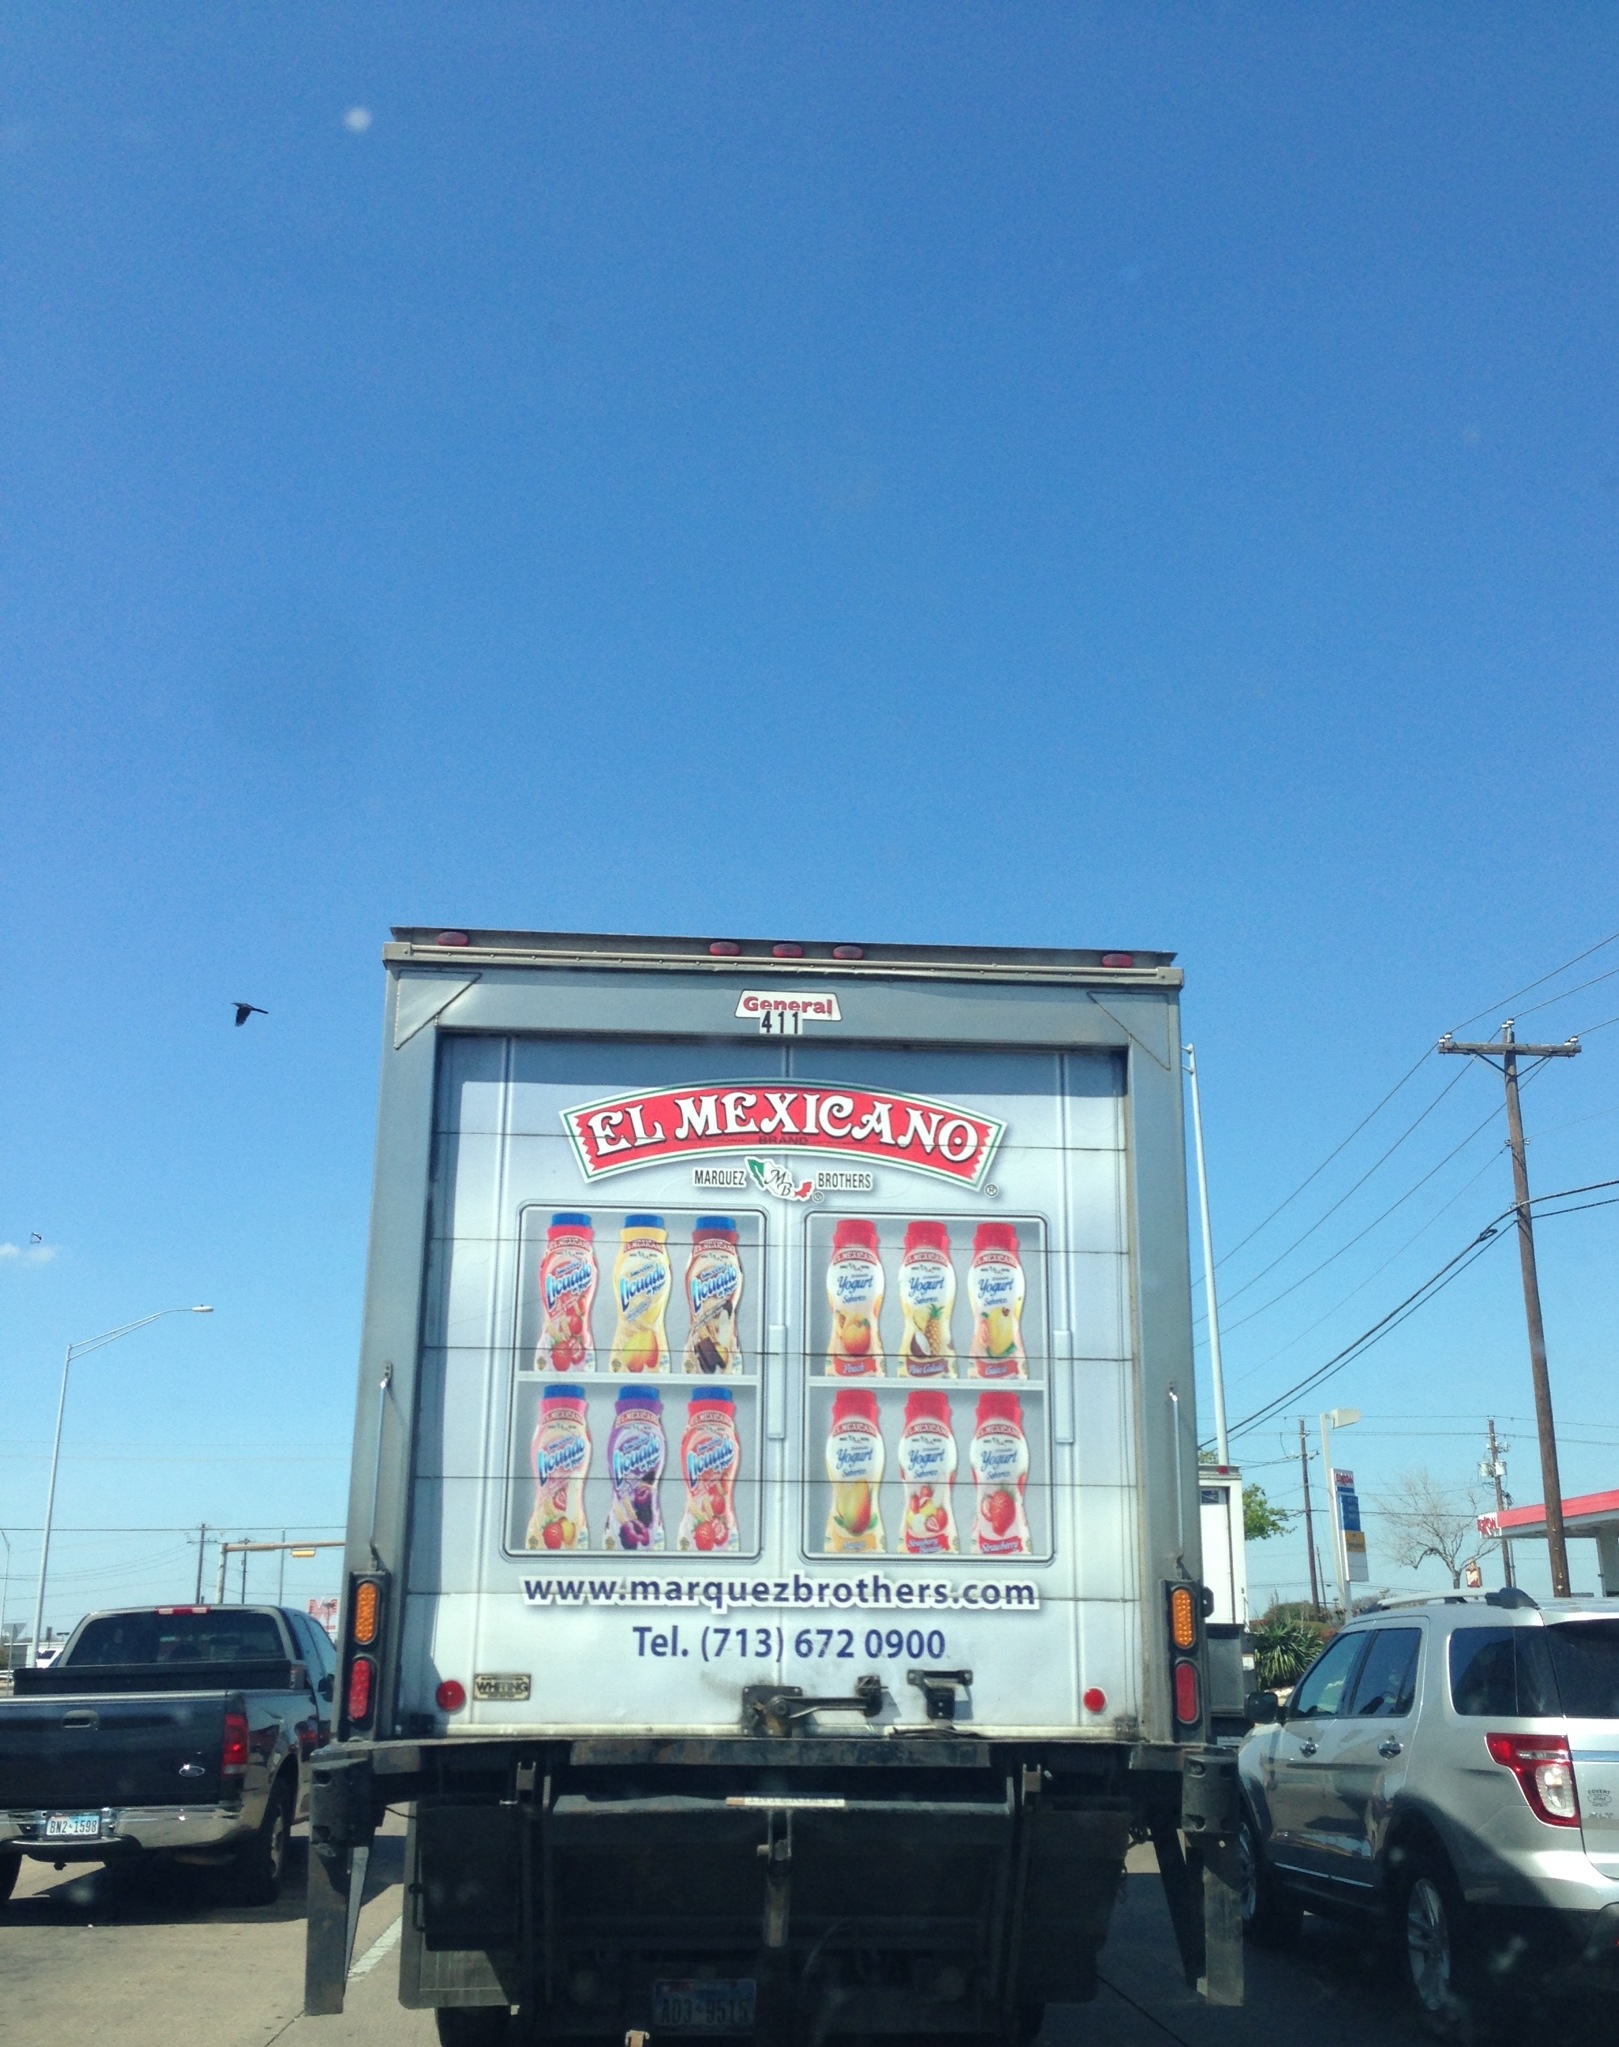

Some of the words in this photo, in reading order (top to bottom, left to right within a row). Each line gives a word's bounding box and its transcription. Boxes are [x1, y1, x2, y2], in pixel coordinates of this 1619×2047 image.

[743, 996, 833, 1015] General
[761, 1010, 799, 1034] 411
[586, 1108, 663, 1157] EL
[674, 1092, 980, 1163] MEXICANO
[693, 1169, 745, 1186] MARQUEZ
[818, 1172, 871, 1189] BROTHERS
[837, 1275, 873, 1296] Yogurt
[908, 1277, 944, 1297] Yogurt
[978, 1279, 1014, 1298] Yogurt
[836, 1448, 873, 1469] Yogurt
[908, 1449, 945, 1470] Yogurt
[981, 1450, 1017, 1471] Yogurt
[524, 1574, 1035, 1609] www.marquezbrothers.com
[632, 1625, 689, 1657] Tel.
[701, 1627, 784, 1662] (713)
[794, 1629, 854, 1658] 672
[864, 1629, 946, 1659] 0900
